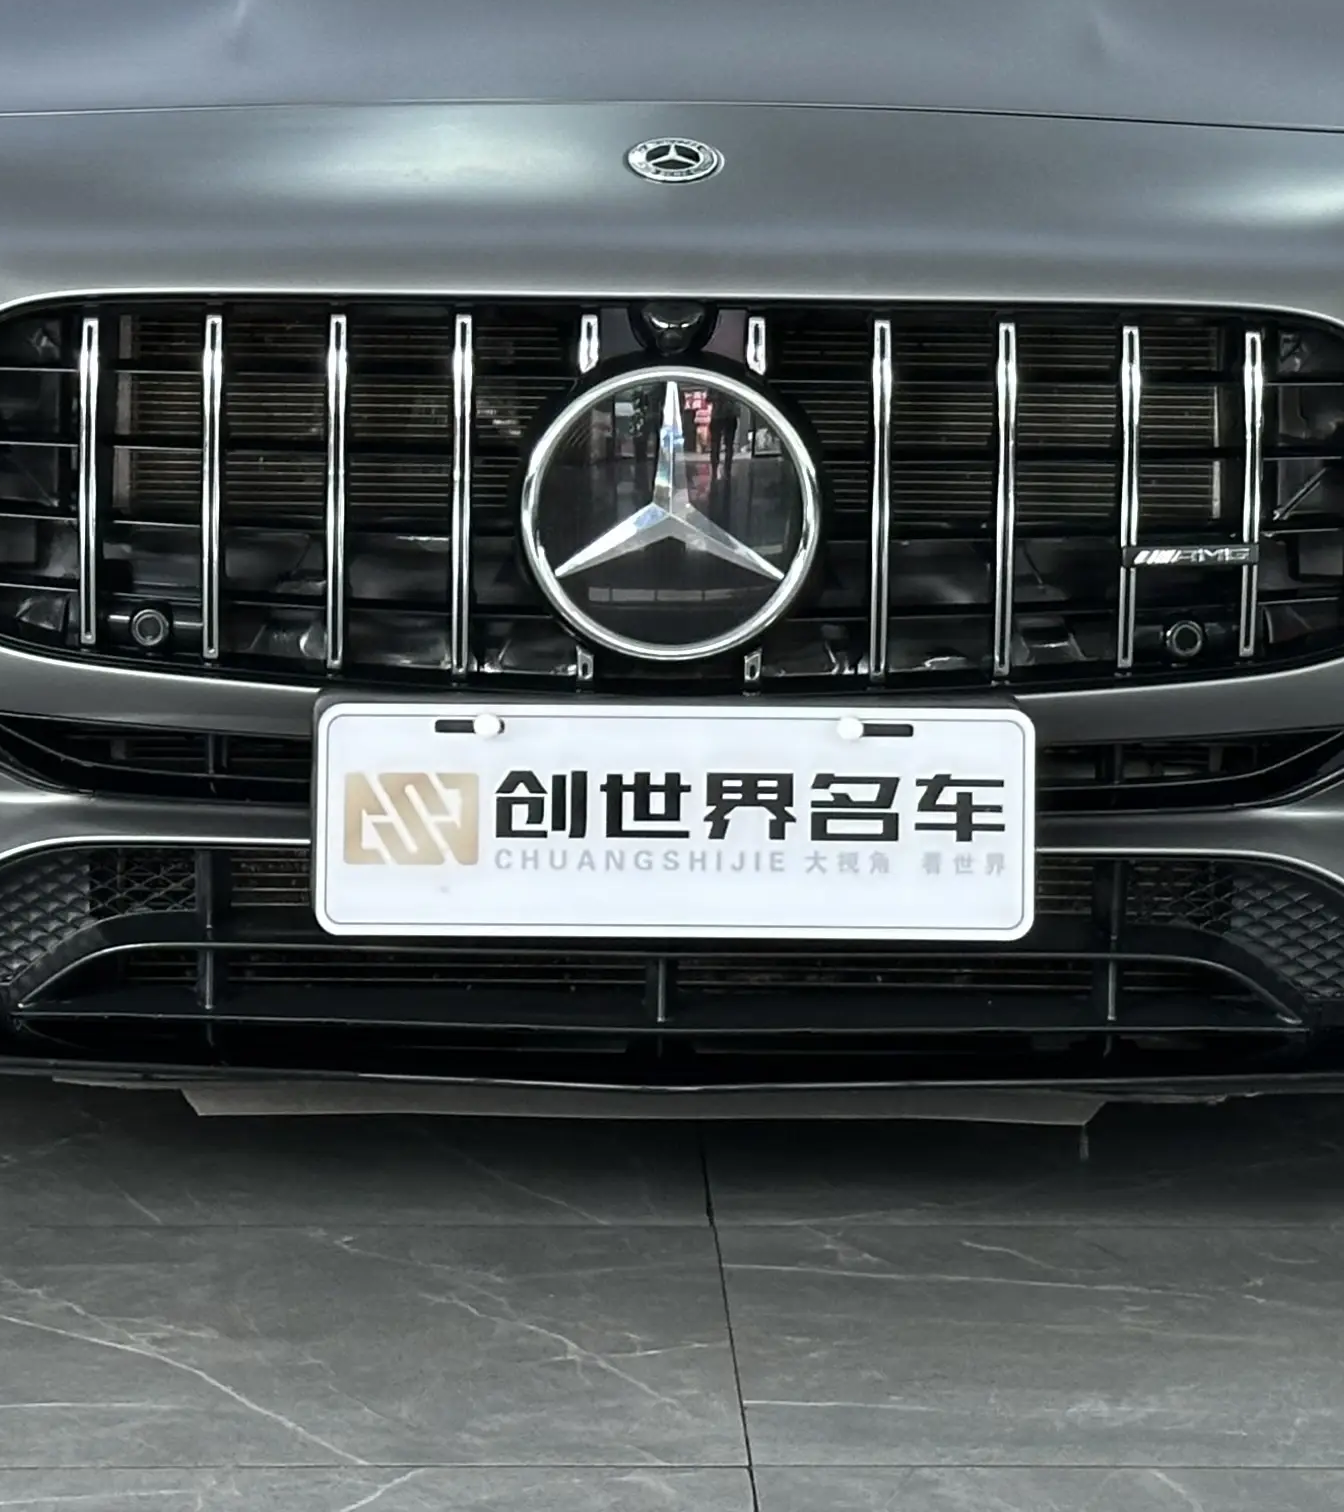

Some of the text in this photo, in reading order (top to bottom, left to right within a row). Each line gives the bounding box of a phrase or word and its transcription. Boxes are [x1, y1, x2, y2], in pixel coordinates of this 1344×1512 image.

[494, 769, 1006, 843] 创世界名车
[493, 847, 788, 875] CHUANGSHIJIE
